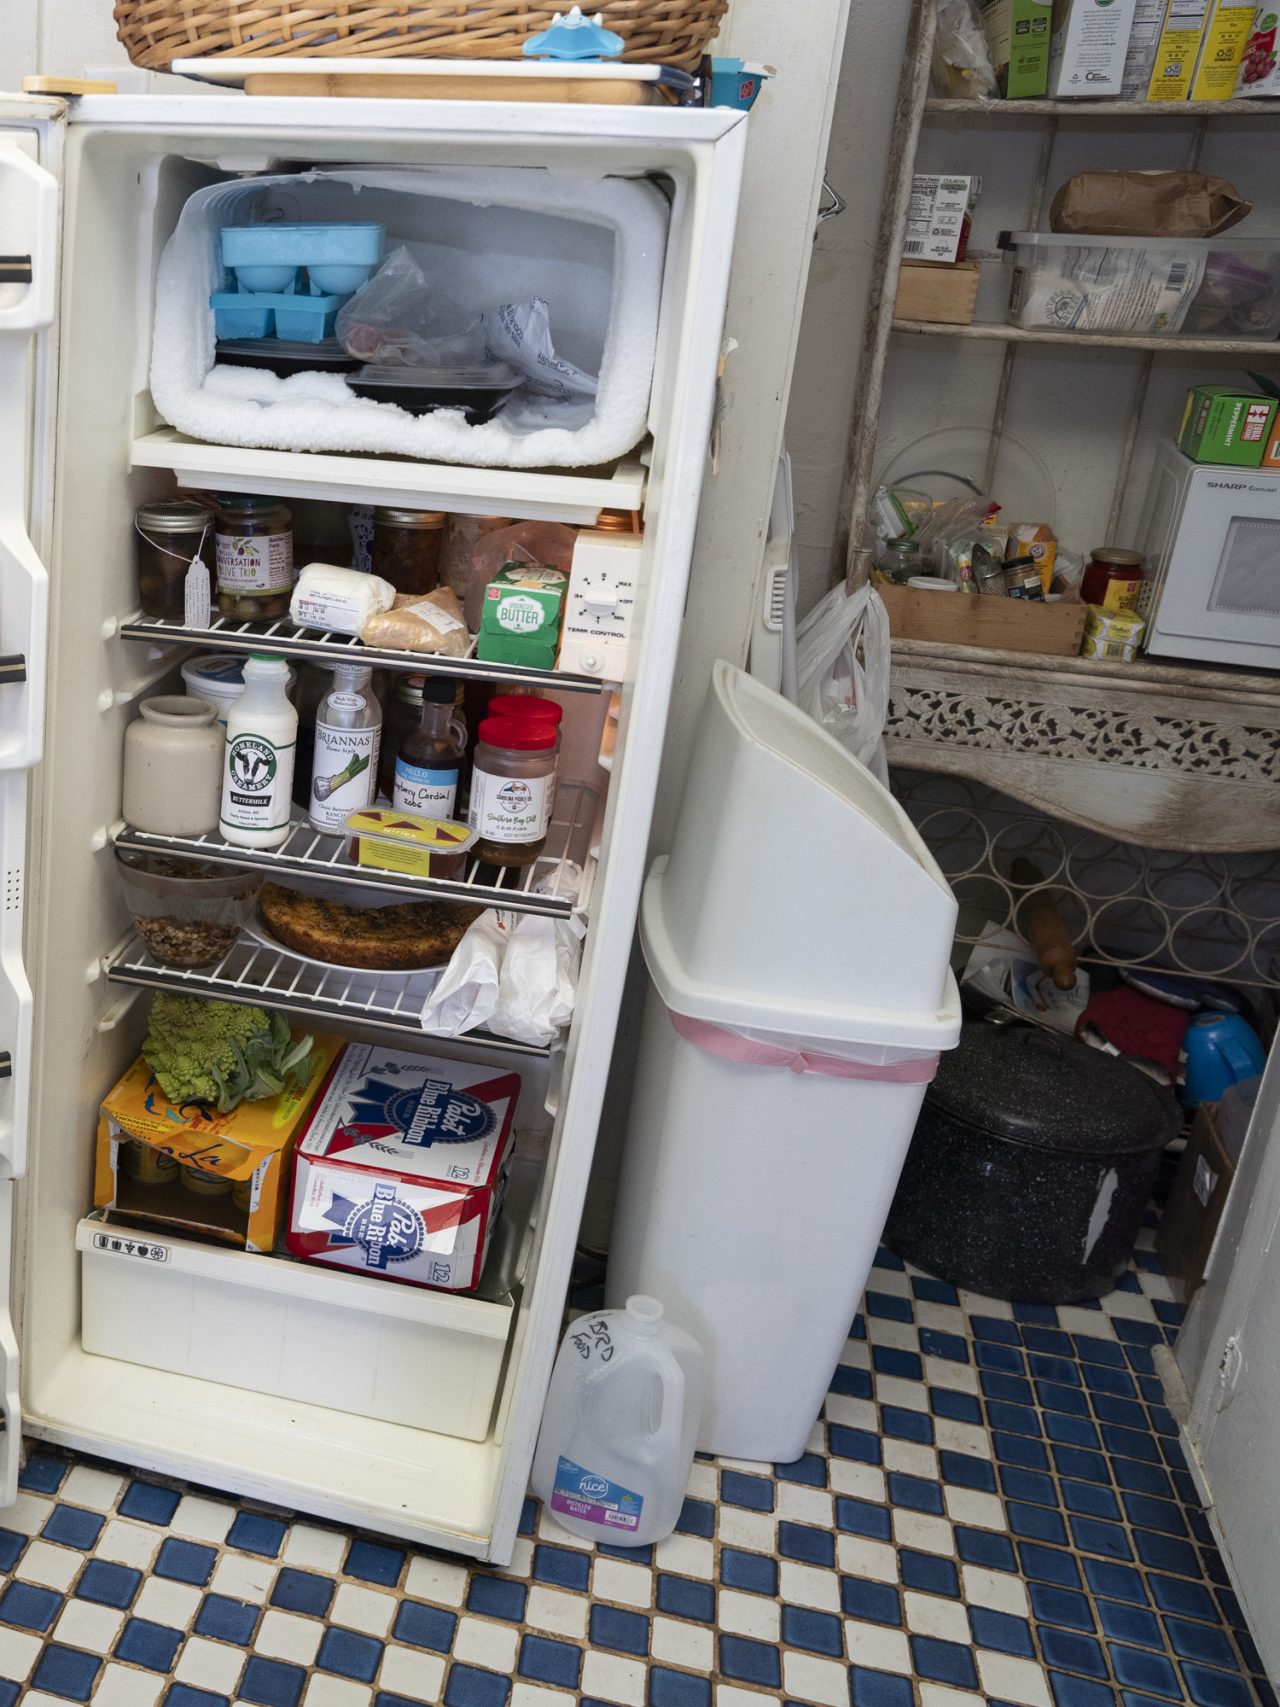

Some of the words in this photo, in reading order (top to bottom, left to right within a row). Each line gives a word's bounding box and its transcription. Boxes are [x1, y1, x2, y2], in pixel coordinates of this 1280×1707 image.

[1224, 402, 1242, 447] PEPPERMINT
[1207, 481, 1247, 490] SHARP
[240, 568, 257, 577] TRIO
[500, 607, 539, 625] BUTTER
[590, 629, 627, 639] CONTROL
[317, 732, 370, 746] BRIANNAS
[231, 741, 274, 760] HOMELAND
[405, 767, 428, 777] HELLO
[231, 769, 273, 791] CREAMERY
[232, 795, 269, 805] BUTTERMILK
[418, 788, 450, 800] Cordial
[487, 812, 513, 823] Southern
[513, 816, 525, 825] Bay
[420, 1080, 450, 1107] Blue
[404, 1103, 442, 1144] Ribbon
[441, 1099, 481, 1136] Pabst
[451, 1165, 470, 1180] 12
[369, 1185, 396, 1223] Blue
[432, 1261, 452, 1284] 12
[579, 1480, 609, 1493] nice!
